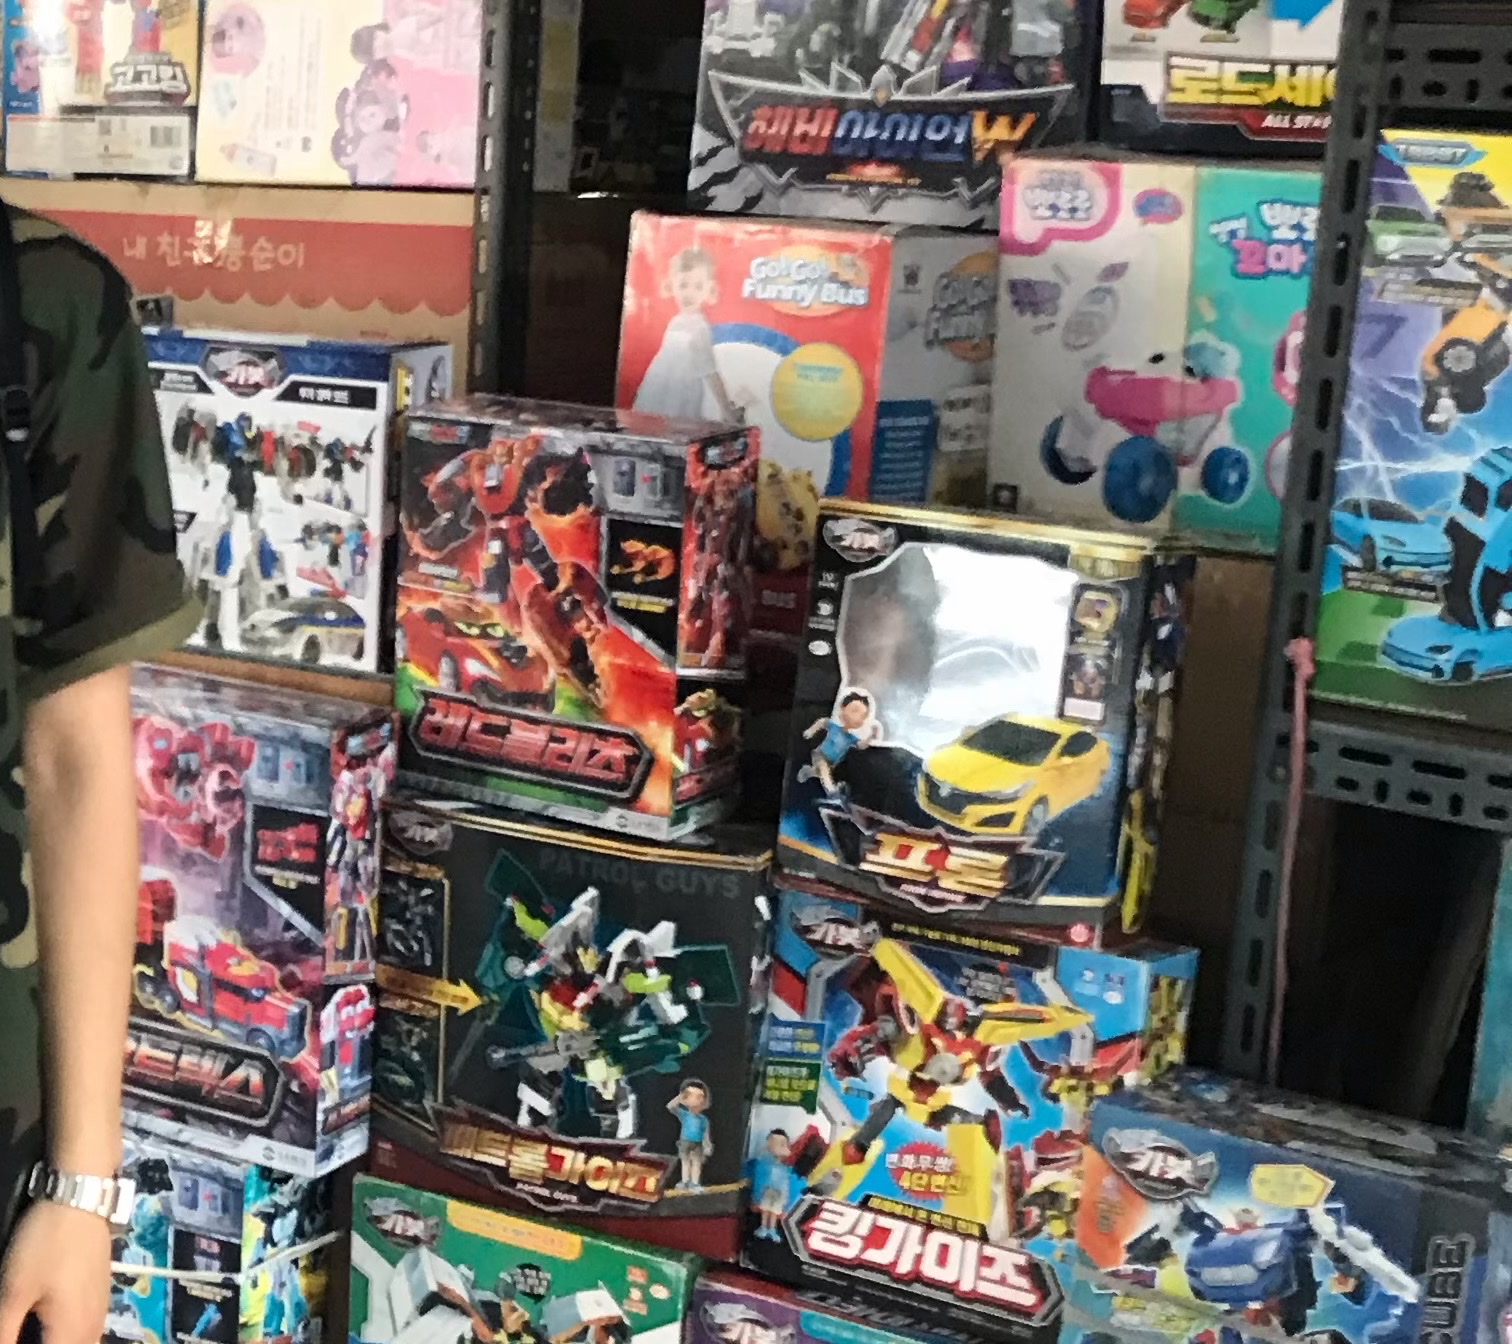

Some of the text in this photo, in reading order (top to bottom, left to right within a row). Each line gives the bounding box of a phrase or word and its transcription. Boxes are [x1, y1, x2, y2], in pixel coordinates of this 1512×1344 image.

[750, 256, 830, 281] Go! Go!
[742, 277, 869, 307] Funny Bus
[538, 849, 741, 900] PATROL GUYS
[809, 1197, 1040, 1309] 킹가이즈
